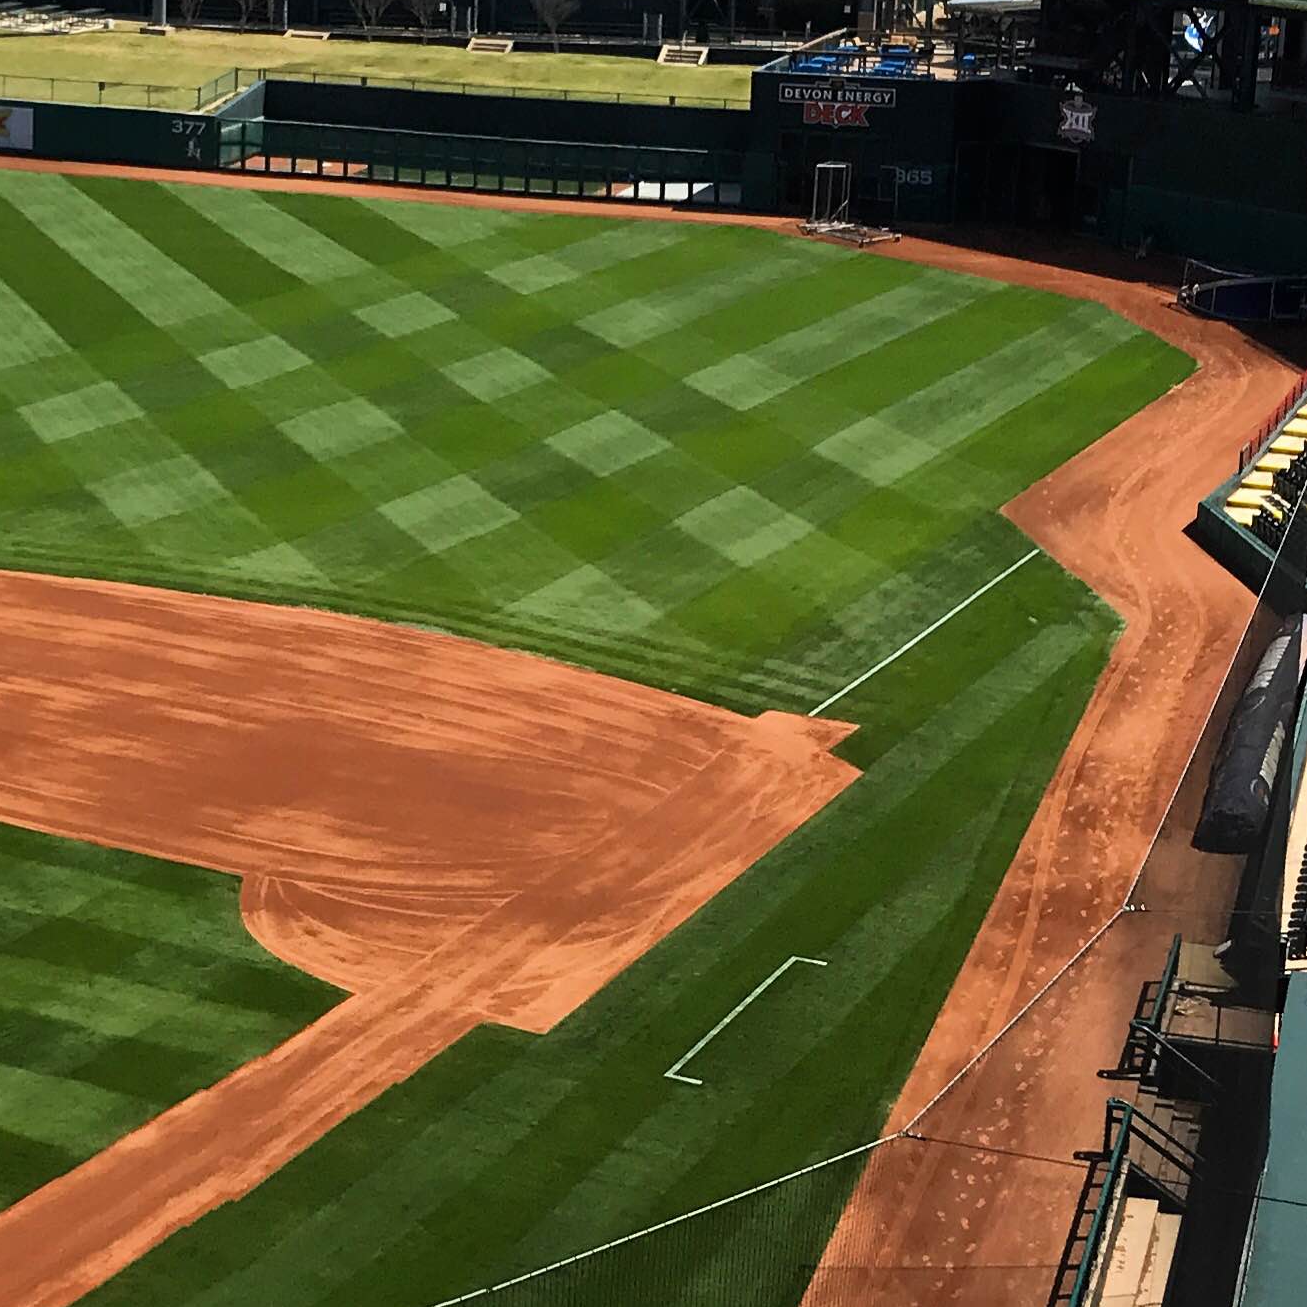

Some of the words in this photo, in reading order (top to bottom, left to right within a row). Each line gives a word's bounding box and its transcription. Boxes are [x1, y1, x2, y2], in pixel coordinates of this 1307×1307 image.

[784, 87, 832, 100] DEVON
[836, 90, 891, 104] ENERGY
[803, 102, 870, 127] DECK
[171, 120, 207, 135] 377
